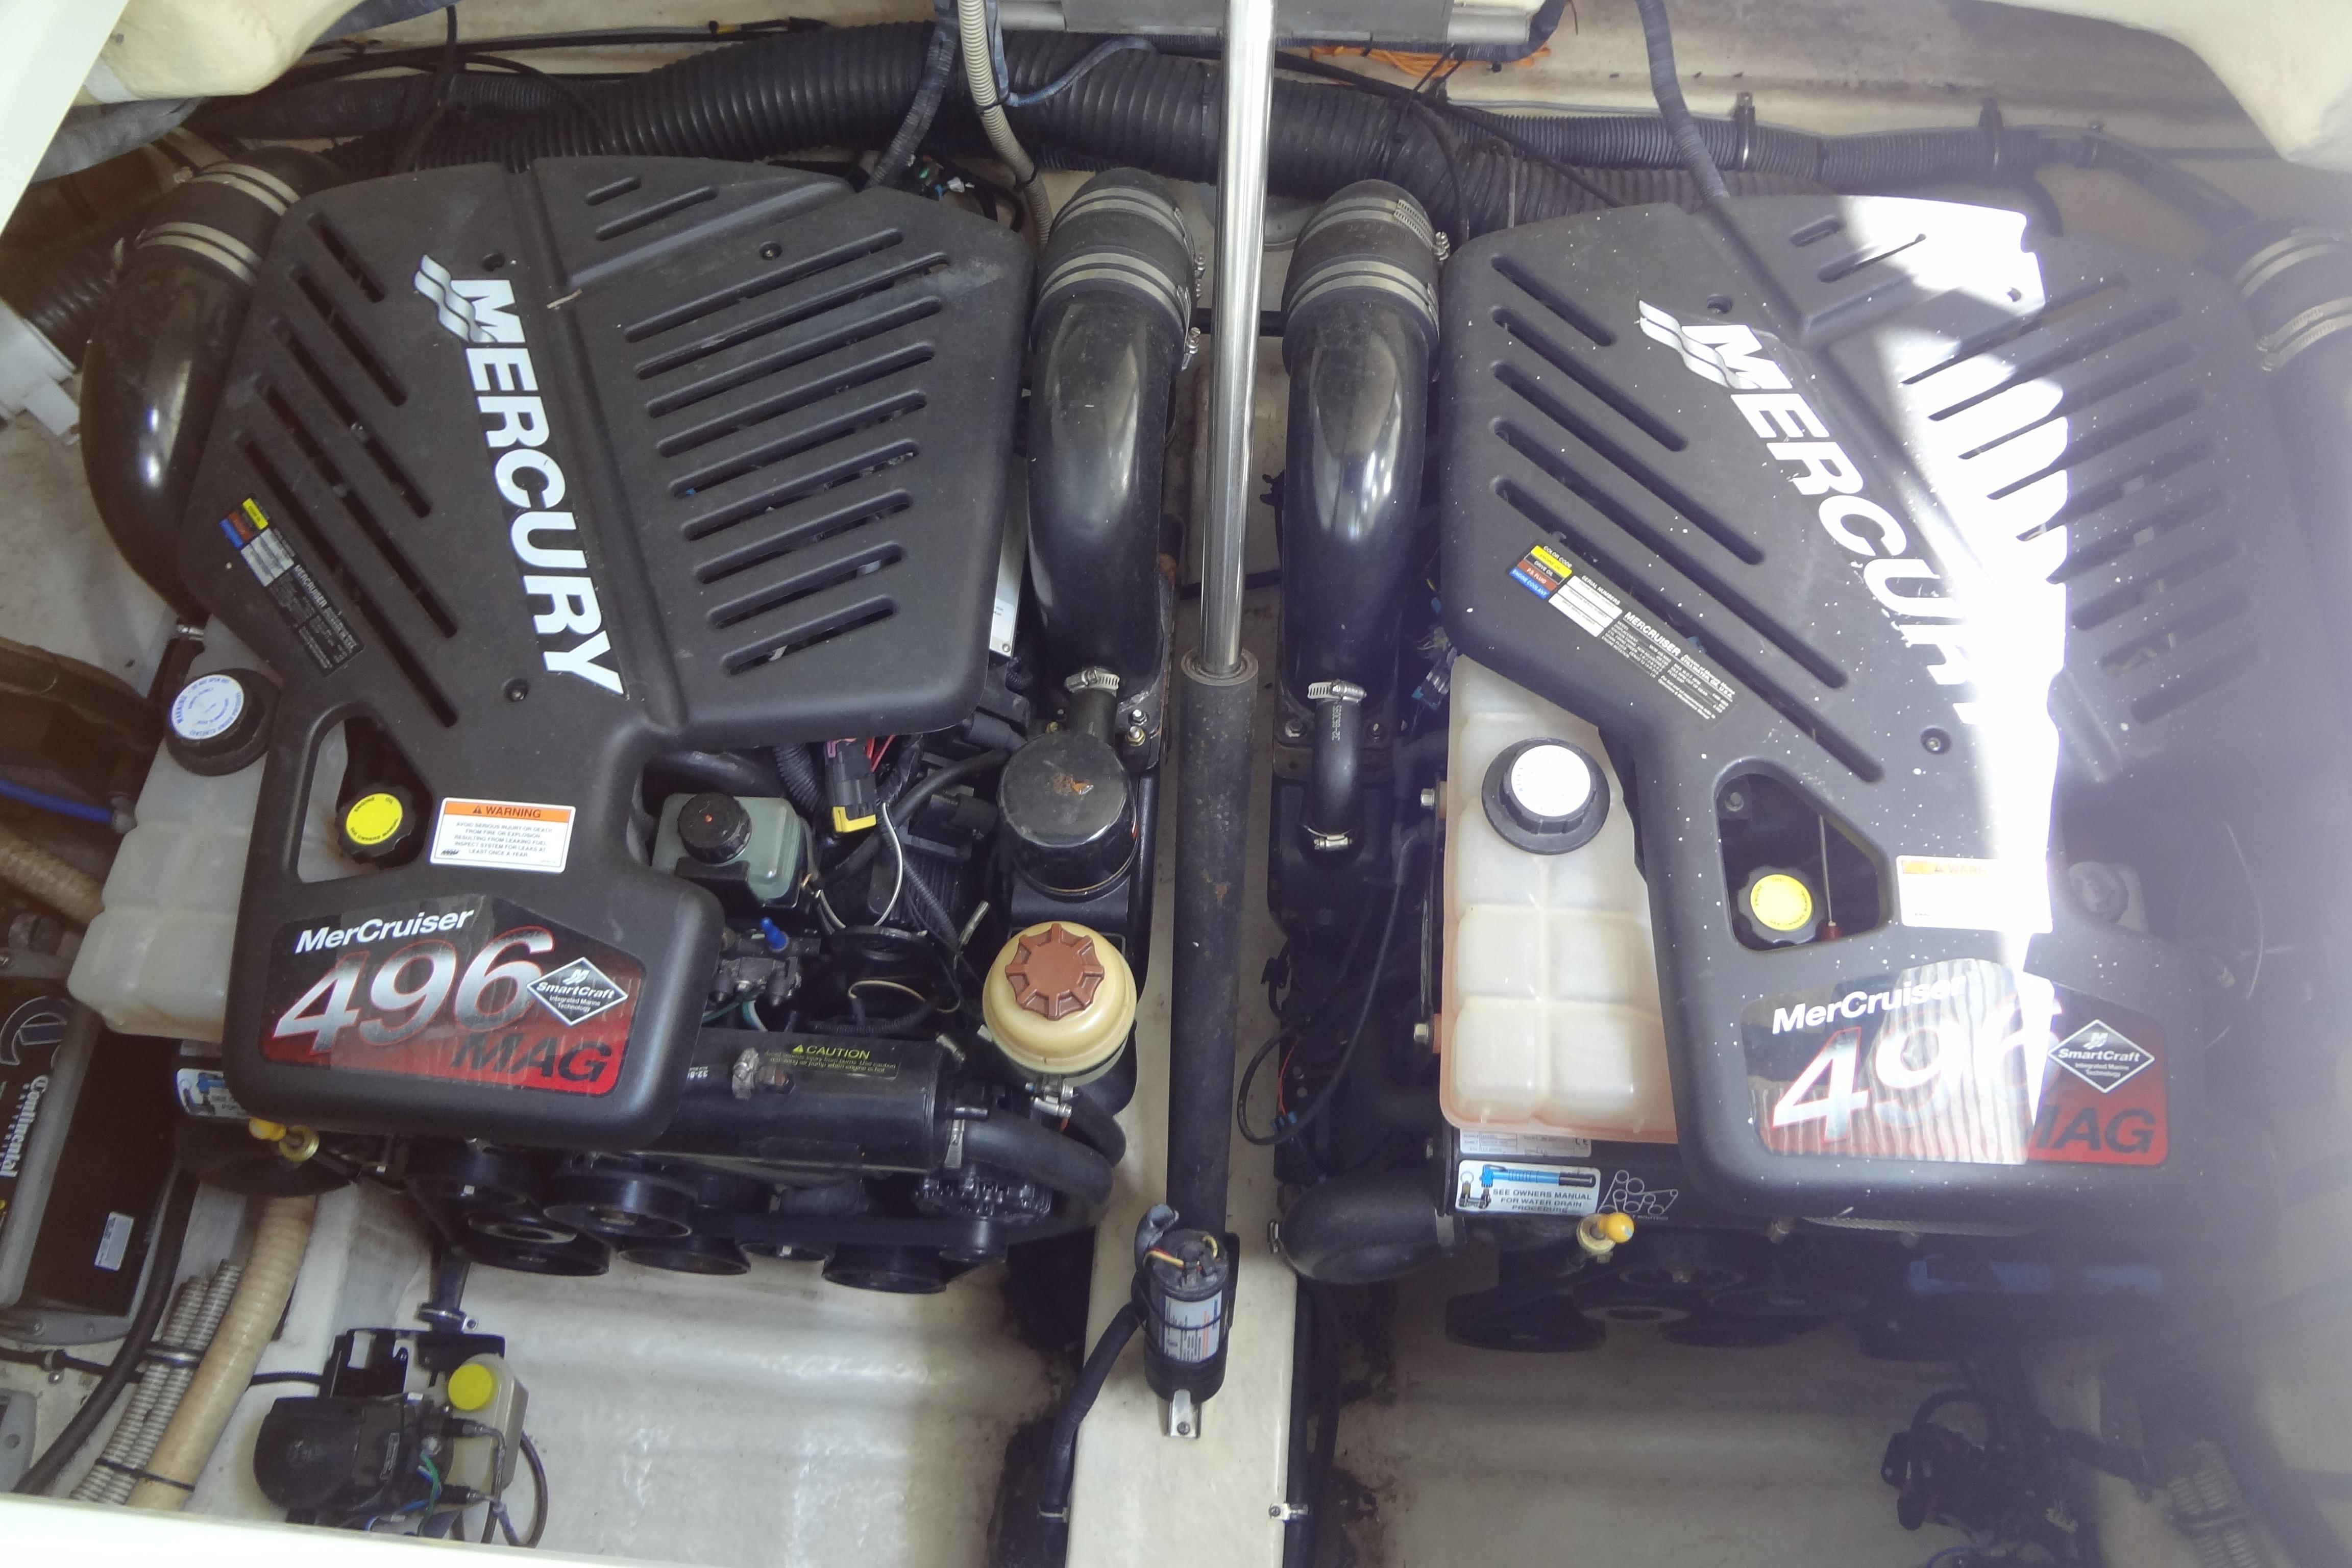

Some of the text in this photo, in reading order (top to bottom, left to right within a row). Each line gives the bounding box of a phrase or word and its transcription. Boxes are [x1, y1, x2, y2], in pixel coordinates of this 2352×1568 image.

[451, 279, 624, 695] MERCURY
[1534, 560, 1546, 571] DRIVE
[1543, 546, 1572, 568] COLOR CODE
[1512, 569, 1547, 597] ENGINE COOLANT
[1534, 573, 1546, 583] FLUID
[1581, 575, 1620, 605] SERIAL NUMBERS
[1624, 610, 1681, 656] MERCRUISER
[485, 805, 542, 818] WARNING
[295, 909, 475, 954] MerCruiser
[272, 924, 556, 1056] 496
[536, 981, 615, 999] SmartCraft
[549, 995, 601, 1007] Integrated Marine
[558, 1002, 591, 1013] Technology
[1772, 975, 1968, 1035] MerCruiser
[451, 1032, 612, 1082] MAG
[806, 1045, 870, 1060] CAUTION
[2058, 1048, 2140, 1062] SmartCraft
[1, 1075, 48, 1178] Continental
[1555, 1192, 1591, 1200] MANUAL
